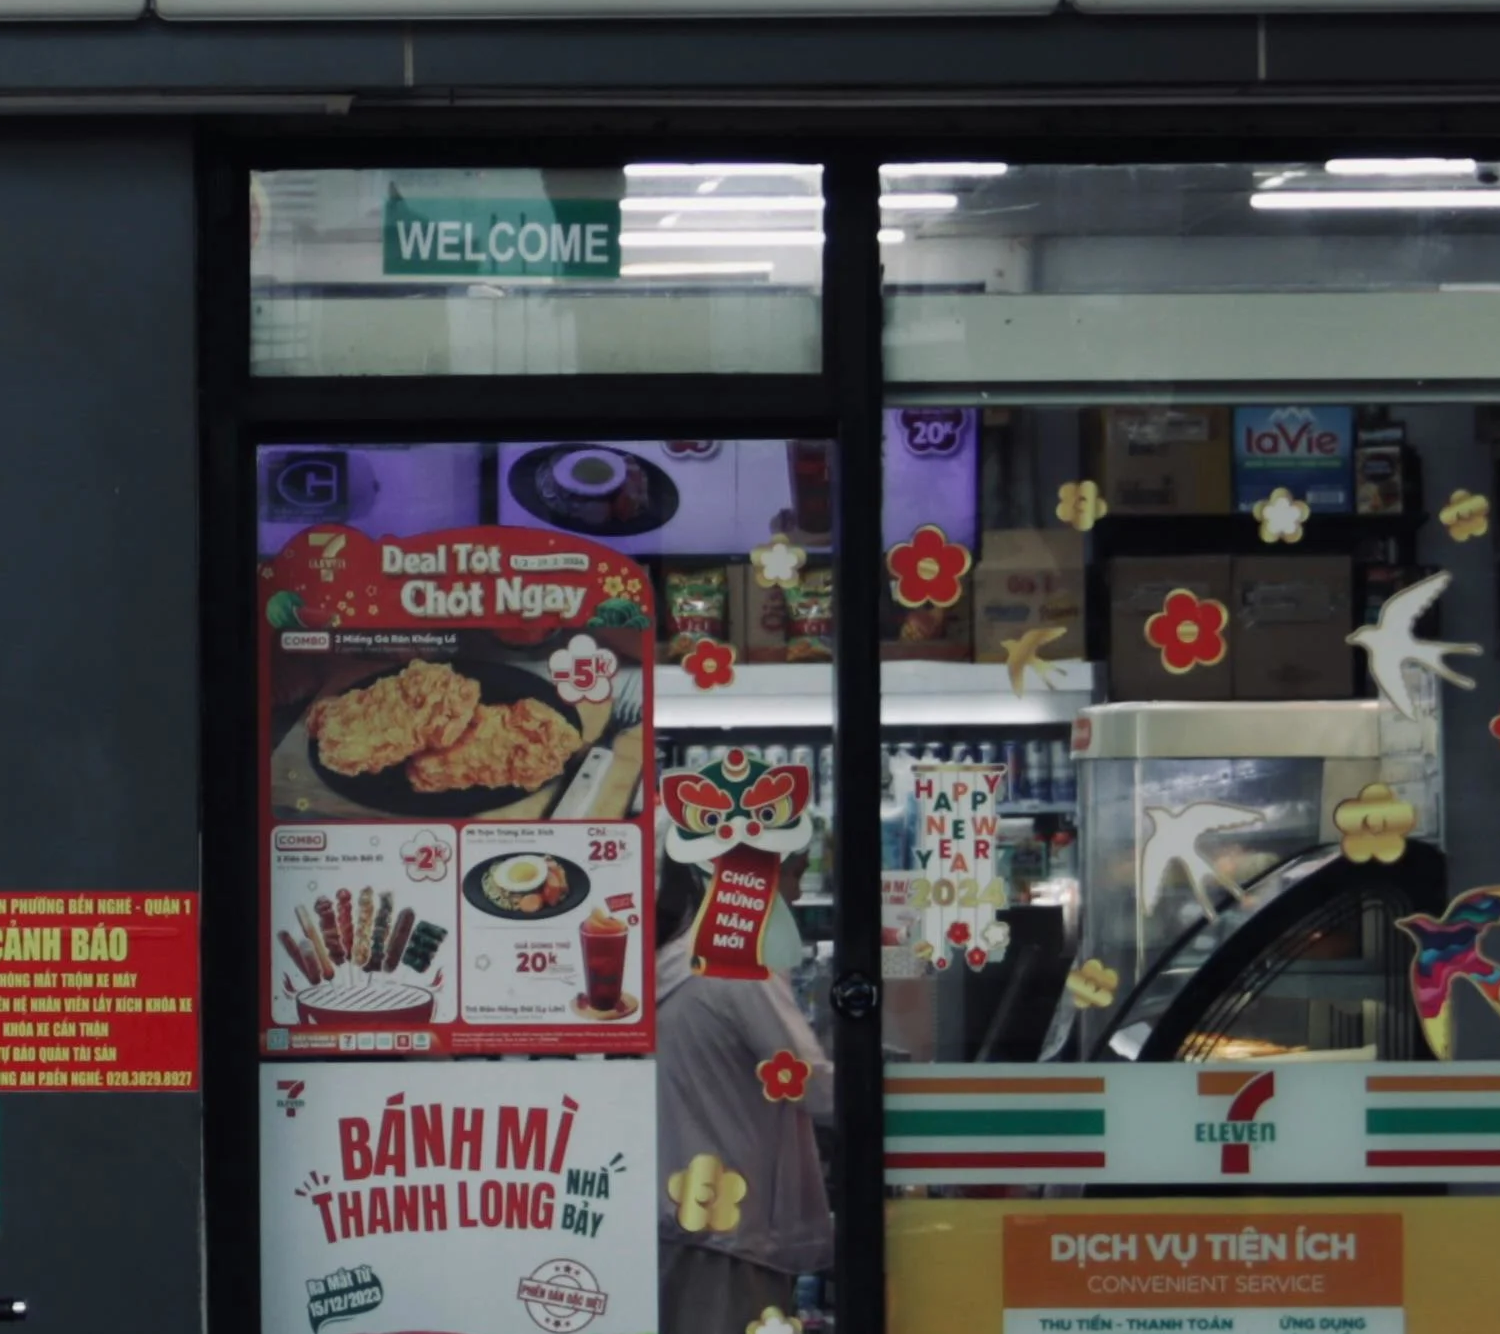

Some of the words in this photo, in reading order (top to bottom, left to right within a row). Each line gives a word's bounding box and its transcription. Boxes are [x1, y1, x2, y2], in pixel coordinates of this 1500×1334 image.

[397, 220, 610, 264] WELCOME
[1245, 422, 1338, 456] laVie
[381, 543, 447, 575] Deal
[451, 541, 502, 575] Tốt
[400, 579, 485, 617] Chốt
[494, 576, 588, 620] Ngay
[283, 634, 328, 645] COMBO
[914, 774, 1001, 813] HAPPY
[279, 835, 322, 845] COMBO
[926, 815, 998, 840] NEW
[915, 838, 991, 873] YEAR
[720, 869, 767, 892] CHÚC
[909, 876, 1006, 910] 2024
[10, 895, 65, 915] PHƯỜNG
[68, 895, 94, 915] BẾN
[97, 895, 132, 915] NGHÉ
[144, 896, 181, 917] QUẬN
[183, 899, 192, 915] 1
[715, 888, 766, 912] MỪNG
[715, 911, 755, 933] NĂM
[70, 921, 129, 962] BÁO
[712, 932, 745, 949] MỚI
[33, 968, 58, 988] MẤT
[60, 970, 94, 990] TRỘM
[96, 972, 111, 988] XE
[112, 969, 138, 988] MÁY
[30, 995, 61, 1013] NHÂN
[63, 995, 90, 1013] VIÊN
[114, 994, 143, 1013] XÍCH
[145, 995, 176, 1013] KHÓA
[178, 996, 193, 1013] XE
[2, 1019, 34, 1038] KHÓA
[36, 1021, 51, 1038] XE
[79, 1019, 110, 1041] THẬN
[12, 1043, 36, 1063] BẢO
[38, 1043, 71, 1063] QUẢN
[72, 1045, 92, 1062] TÀI
[93, 1043, 118, 1062] SẢN
[1197, 1070, 1274, 1174] 7
[338, 1091, 485, 1182] BÁNH
[495, 1093, 580, 1175] MÌ
[565, 1166, 610, 1200] NHÀ
[311, 1183, 449, 1245] THANH
[457, 1179, 556, 1230] LONG
[561, 1199, 605, 1239] BẢY
[1050, 1233, 1137, 1269] DỊCH
[1145, 1233, 1198, 1269] VỤ
[1204, 1225, 1289, 1269] TIỆN
[1295, 1225, 1357, 1262] ÍCH
[306, 1278, 325, 1295] Ra
[326, 1267, 354, 1289] Mắt
[1088, 1274, 1229, 1294] CONVENIENT
[1235, 1274, 1325, 1294] SERVICE
[308, 1285, 383, 1318] 15/12/2023
[1039, 1318, 1072, 1331] THU
[1076, 1314, 1113, 1331] TIỀN
[1126, 1318, 1183, 1331] THANH
[1184, 1314, 1234, 1331] TOÁN
[1319, 1317, 1367, 1332] DỤNG
